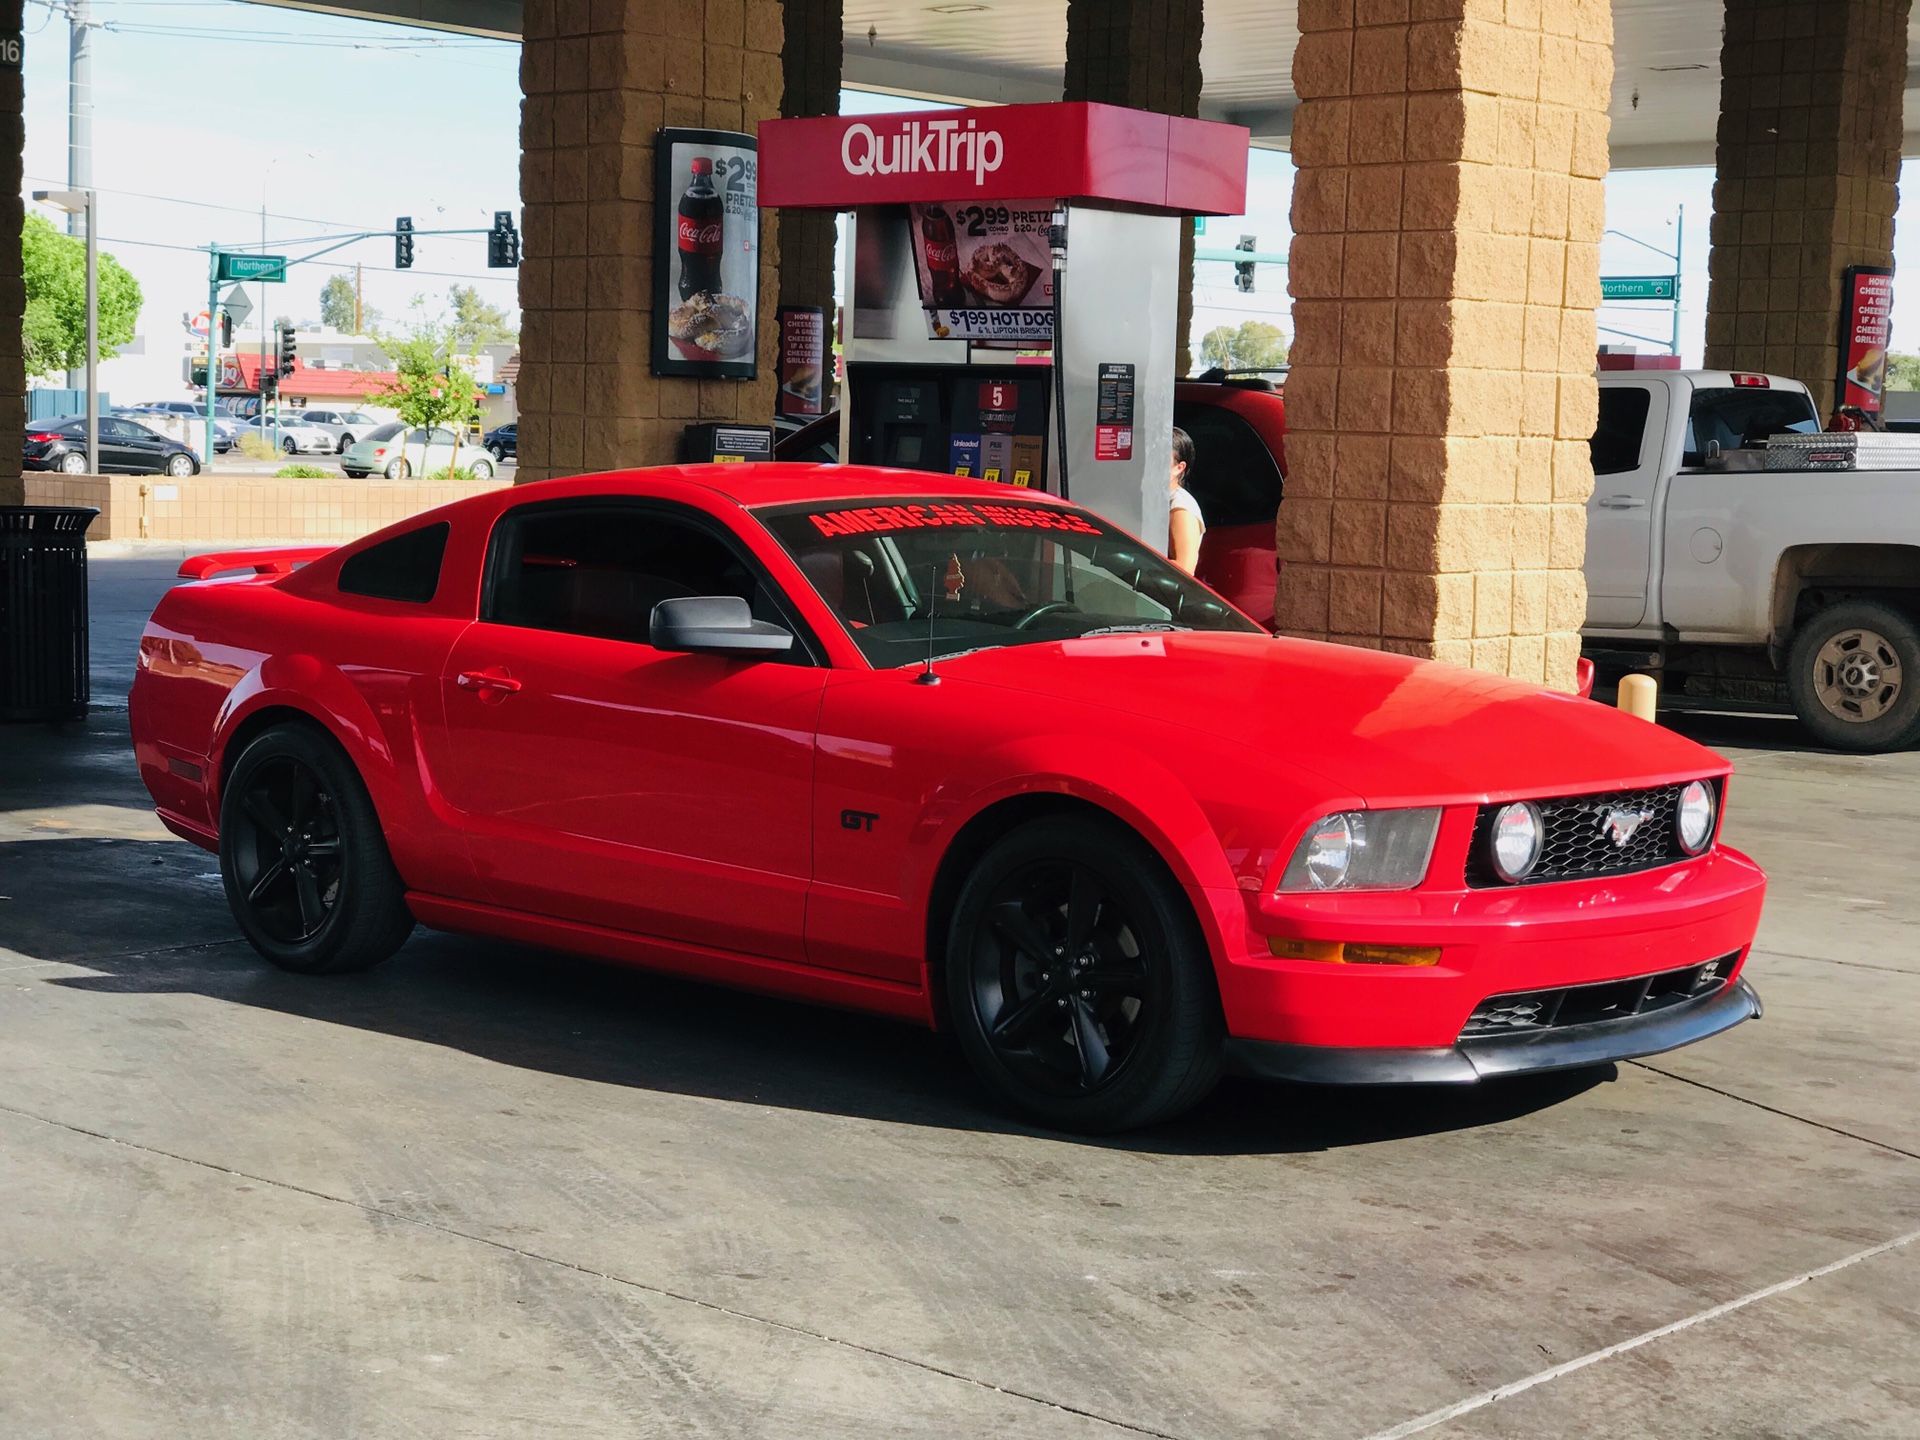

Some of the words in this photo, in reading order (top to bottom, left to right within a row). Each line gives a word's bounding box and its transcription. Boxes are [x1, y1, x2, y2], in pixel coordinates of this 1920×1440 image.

[0, 39, 20, 63] 16
[841, 119, 1004, 186] QuikTrip
[956, 205, 1009, 237] $299
[237, 261, 275, 271] Northern
[1601, 283, 1644, 293] Northern
[949, 309, 989, 332] $199
[991, 312, 1020, 326] HOT
[993, 386, 1003, 407] 5
[953, 440, 979, 448] Unleaded
[808, 505, 987, 537] AMERICAN
[972, 504, 1104, 535] MUSCLE
[841, 809, 880, 832] GT
